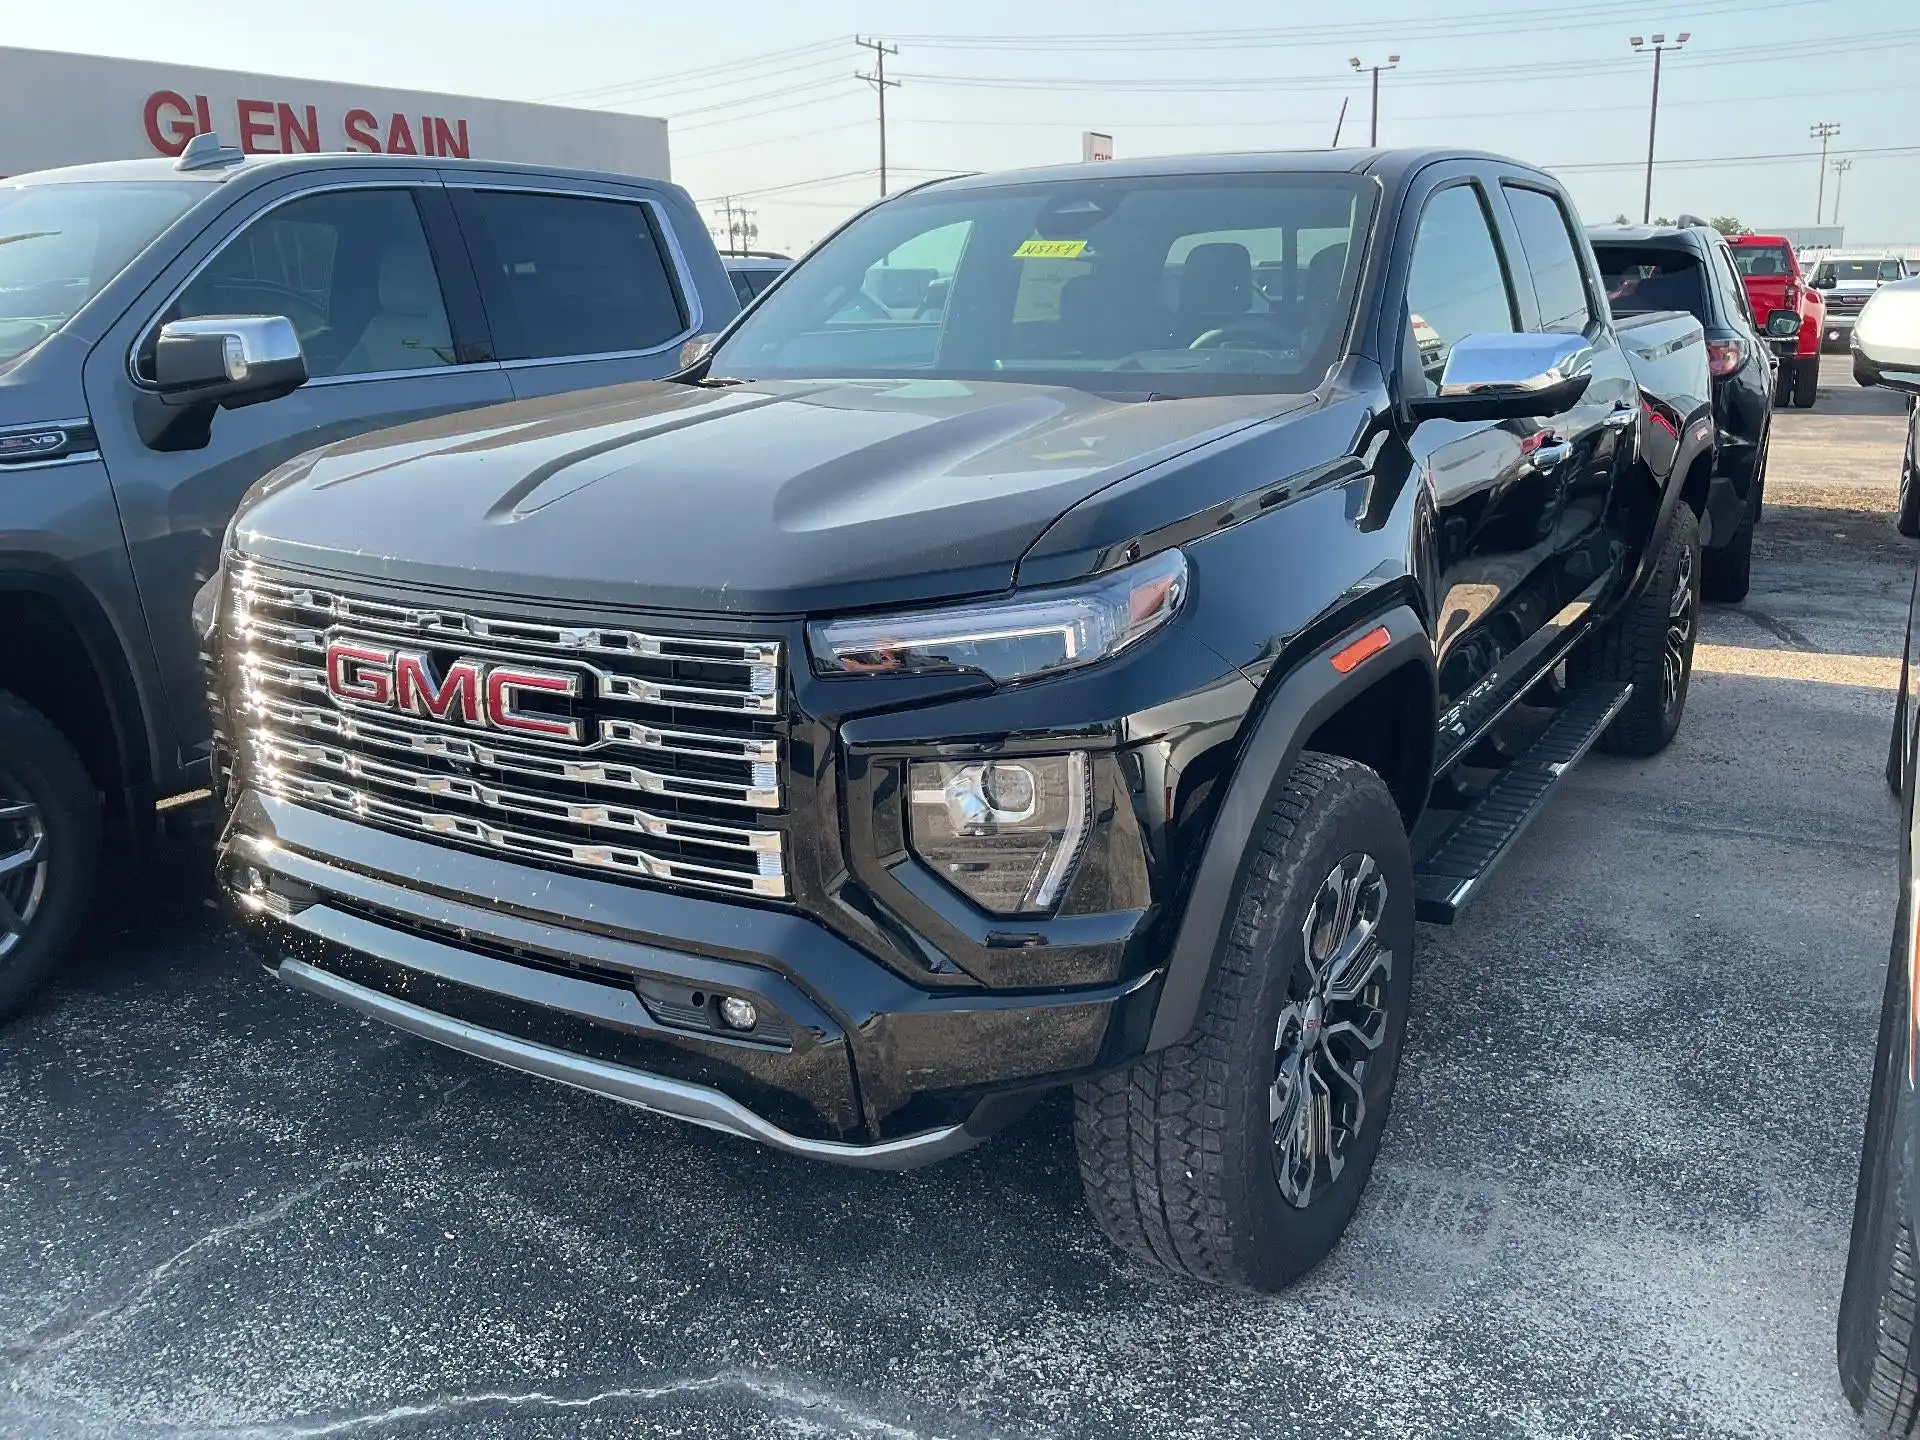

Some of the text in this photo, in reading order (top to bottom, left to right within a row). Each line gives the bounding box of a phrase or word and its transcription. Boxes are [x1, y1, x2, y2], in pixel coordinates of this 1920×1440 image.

[144, 90, 470, 158] GLEN SAIN
[326, 640, 584, 740] GMC
